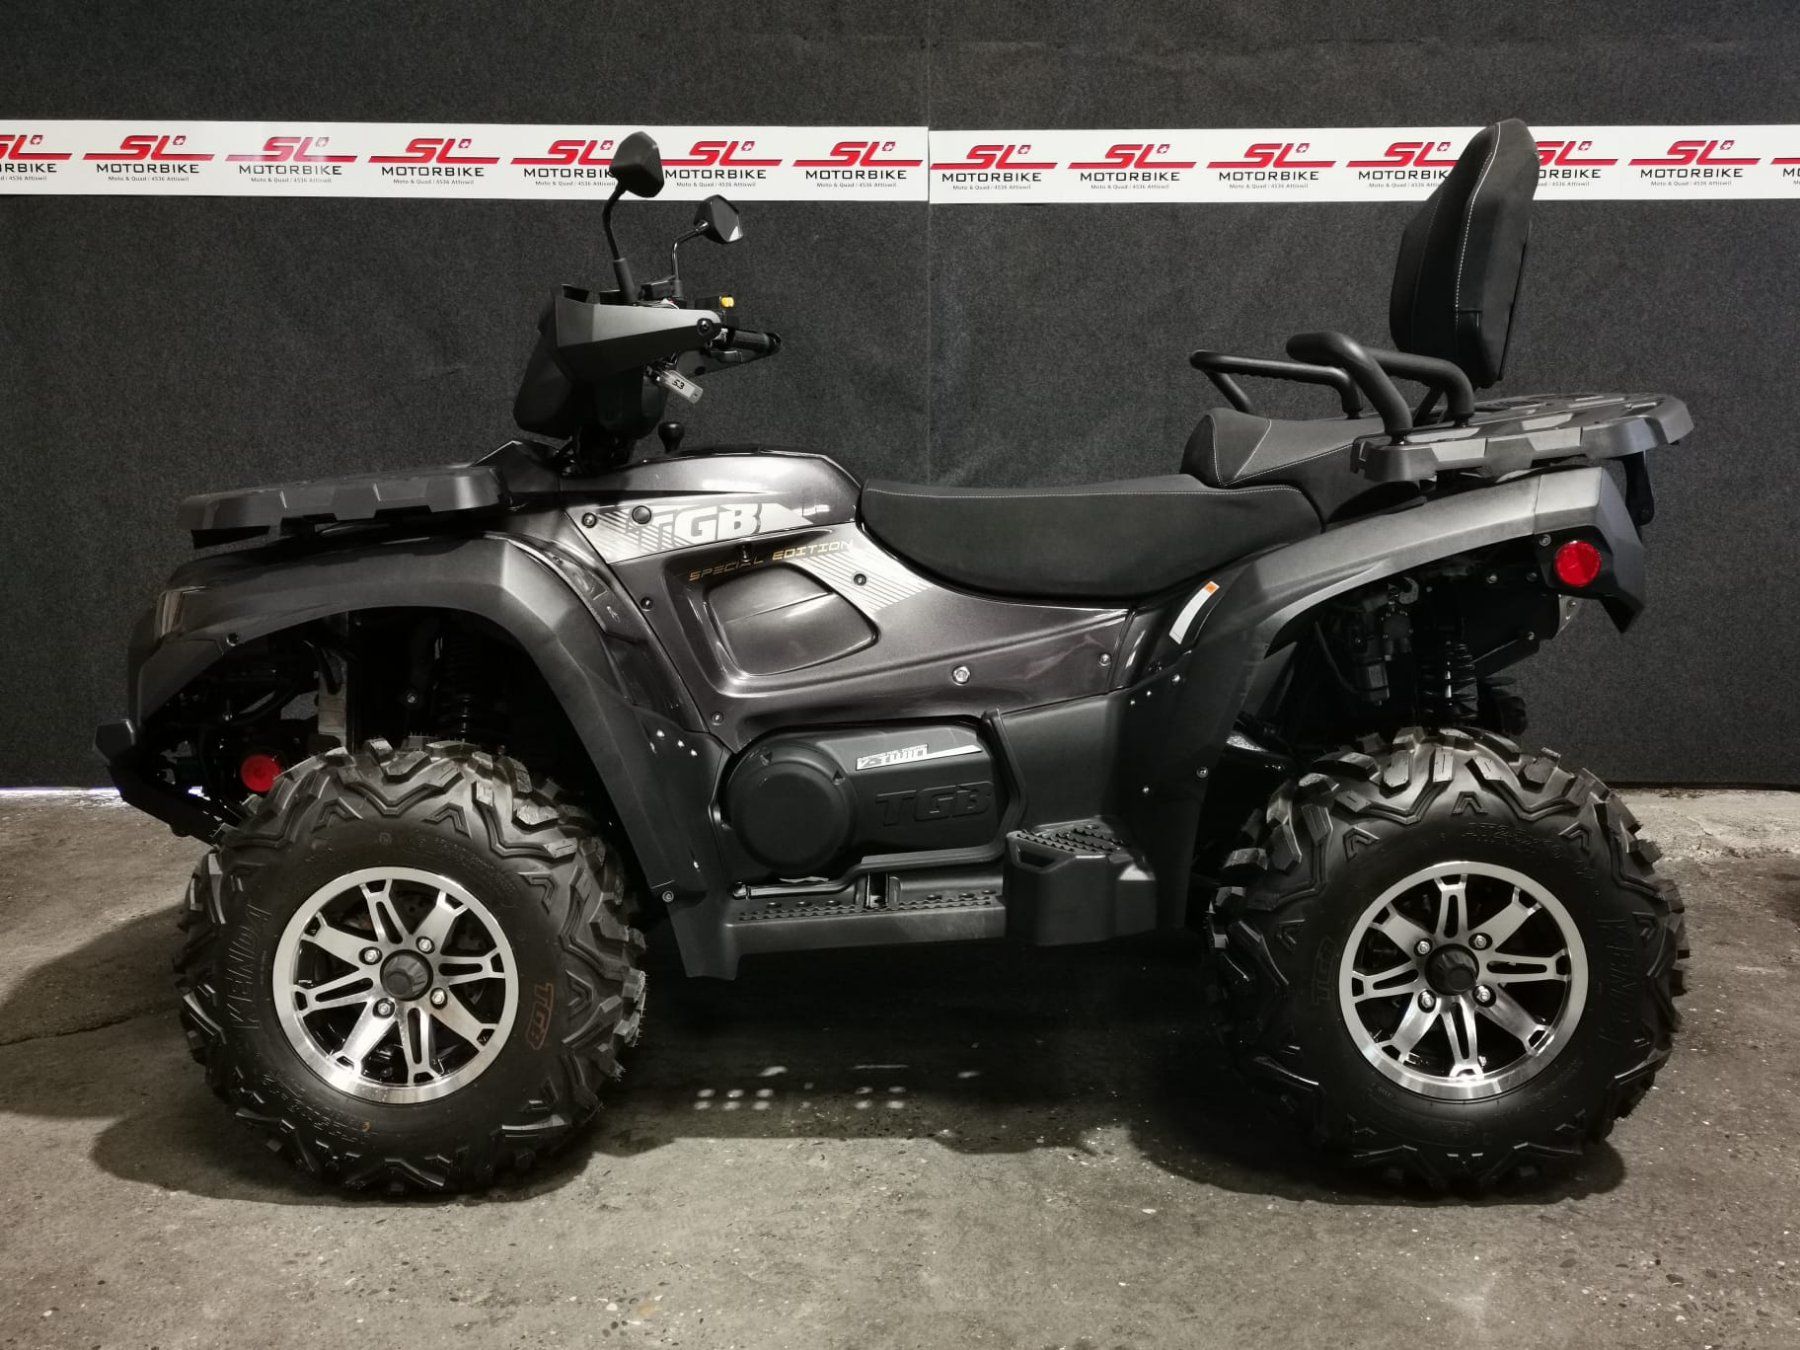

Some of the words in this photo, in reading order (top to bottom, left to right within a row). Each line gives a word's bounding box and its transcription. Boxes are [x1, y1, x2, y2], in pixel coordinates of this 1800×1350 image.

[96, 163, 199, 173] MOTORBIKE
[239, 165, 342, 175] MOTORBIKE
[381, 167, 484, 176] MOTORBIKE
[523, 168, 612, 178] MOTORBIK
[1640, 168, 1743, 178] MOTORBIKE
[665, 169, 766, 179] MOTORBIKE
[805, 170, 907, 179] MOTORBIKE
[941, 172, 1042, 182] MOTORBIKE
[1080, 172, 1180, 181] MOTORBIKE
[1219, 171, 1319, 181] MOTORBIKE
[1358, 170, 1449, 180] MOTORBIK
[1539, 169, 1601, 178] ORBIKE
[625, 502, 763, 549] TGB
[689, 556, 764, 581] SPECIAL
[772, 541, 853, 561] EDITION
[876, 781, 994, 826] TGB
